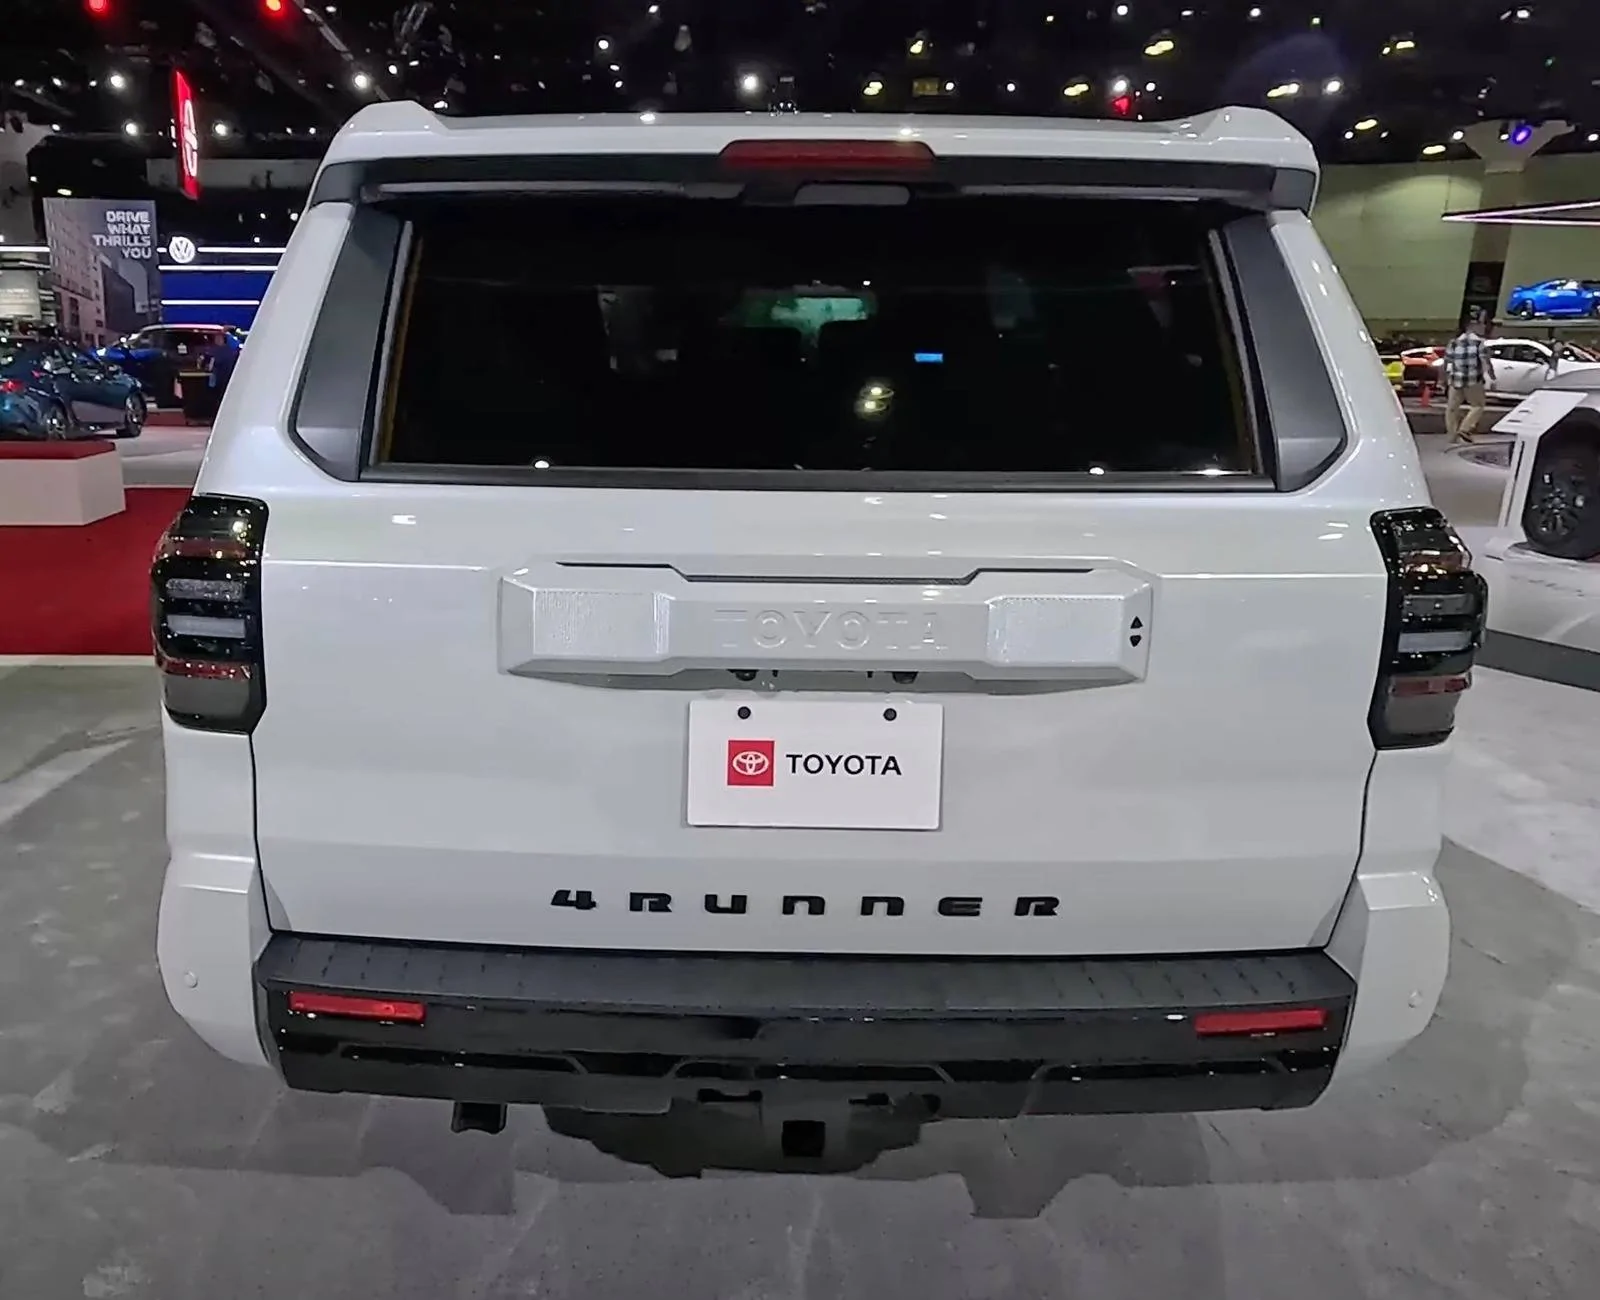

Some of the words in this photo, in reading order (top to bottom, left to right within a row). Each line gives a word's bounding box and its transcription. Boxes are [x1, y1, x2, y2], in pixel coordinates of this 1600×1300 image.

[106, 211, 150, 223] DRIVE
[107, 224, 150, 235] WHAT
[92, 235, 151, 247] THRILLS
[122, 248, 151, 259] YOU
[712, 609, 950, 650] TOYOTA
[785, 753, 903, 776] TOYOTA
